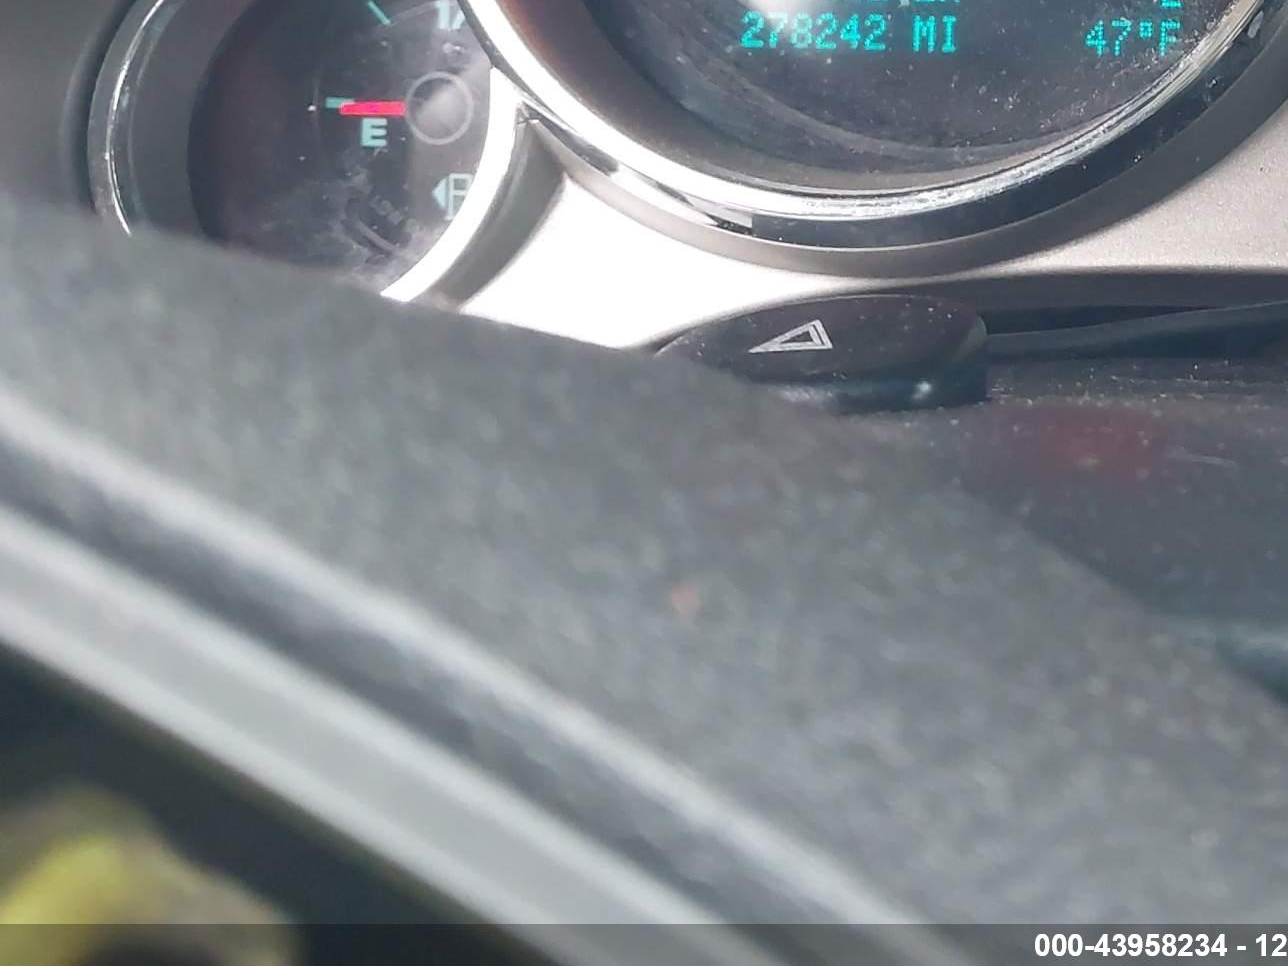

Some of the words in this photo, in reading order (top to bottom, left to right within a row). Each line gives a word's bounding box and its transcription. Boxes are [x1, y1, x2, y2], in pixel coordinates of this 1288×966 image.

[740, 12, 887, 52] 278242
[912, 15, 957, 53] MI
[1085, 19, 1181, 56] 47°F
[360, 118, 387, 147] E
